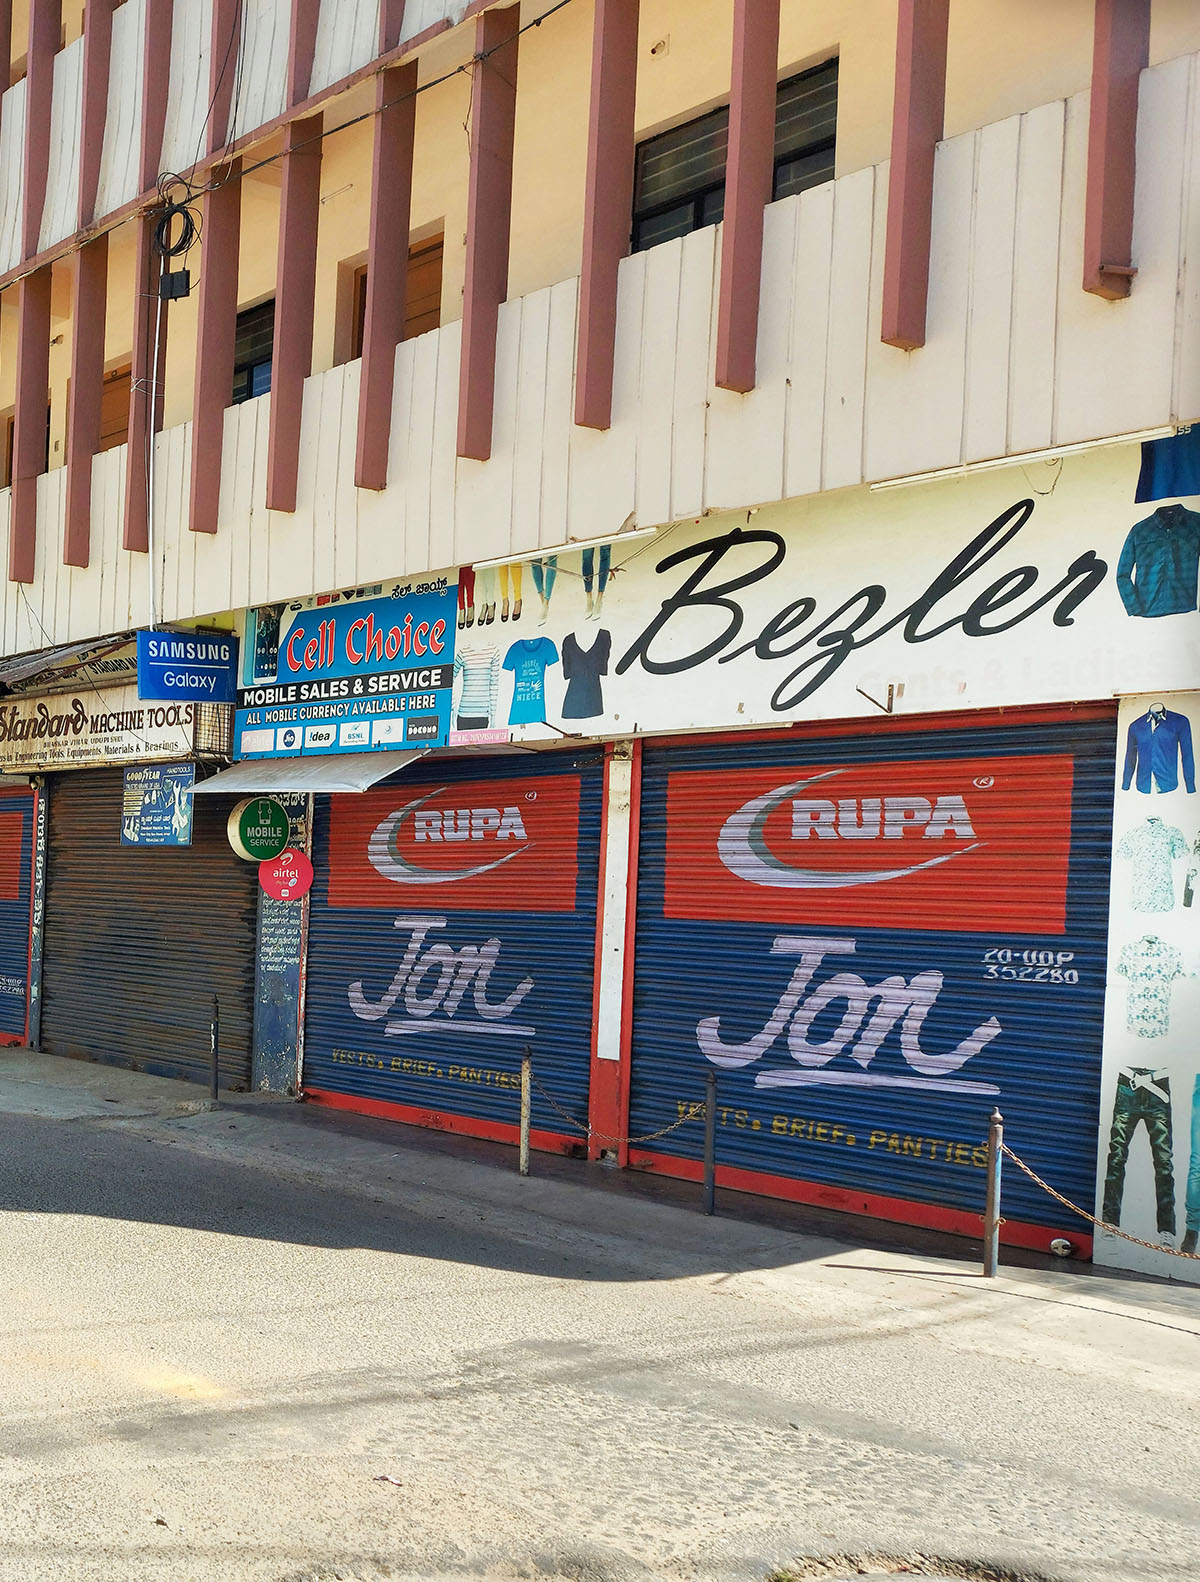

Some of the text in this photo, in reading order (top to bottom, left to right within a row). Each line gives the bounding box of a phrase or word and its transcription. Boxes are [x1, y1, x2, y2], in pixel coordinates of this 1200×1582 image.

[615, 496, 1108, 711] Bezler
[148, 640, 230, 661] SAMSUNG
[286, 612, 447, 673] Cell Choice
[163, 671, 217, 693] Galaxy
[244, 669, 442, 706] MOBILE SALES & SERVICE
[89, 709, 145, 735] MACHINE
[147, 703, 194, 728] TOOLS
[246, 694, 436, 725] ALL MOBILE CURRENCY AVAILABLE HERE
[104, 743, 134, 755] Materials
[283, 731, 296, 744] Jio
[347, 732, 364, 740] BSNL
[414, 806, 528, 843] RUPA
[791, 795, 978, 840] RUPA
[247, 827, 282, 837] MOBILE
[250, 838, 280, 847] SERVICE
[273, 868, 299, 878] airtel
[982, 963, 1080, 985] 352280
[696, 934, 1002, 1076] Jon
[448, 1064, 522, 1090] PANTIES
[867, 1130, 989, 1168] PANTIES
